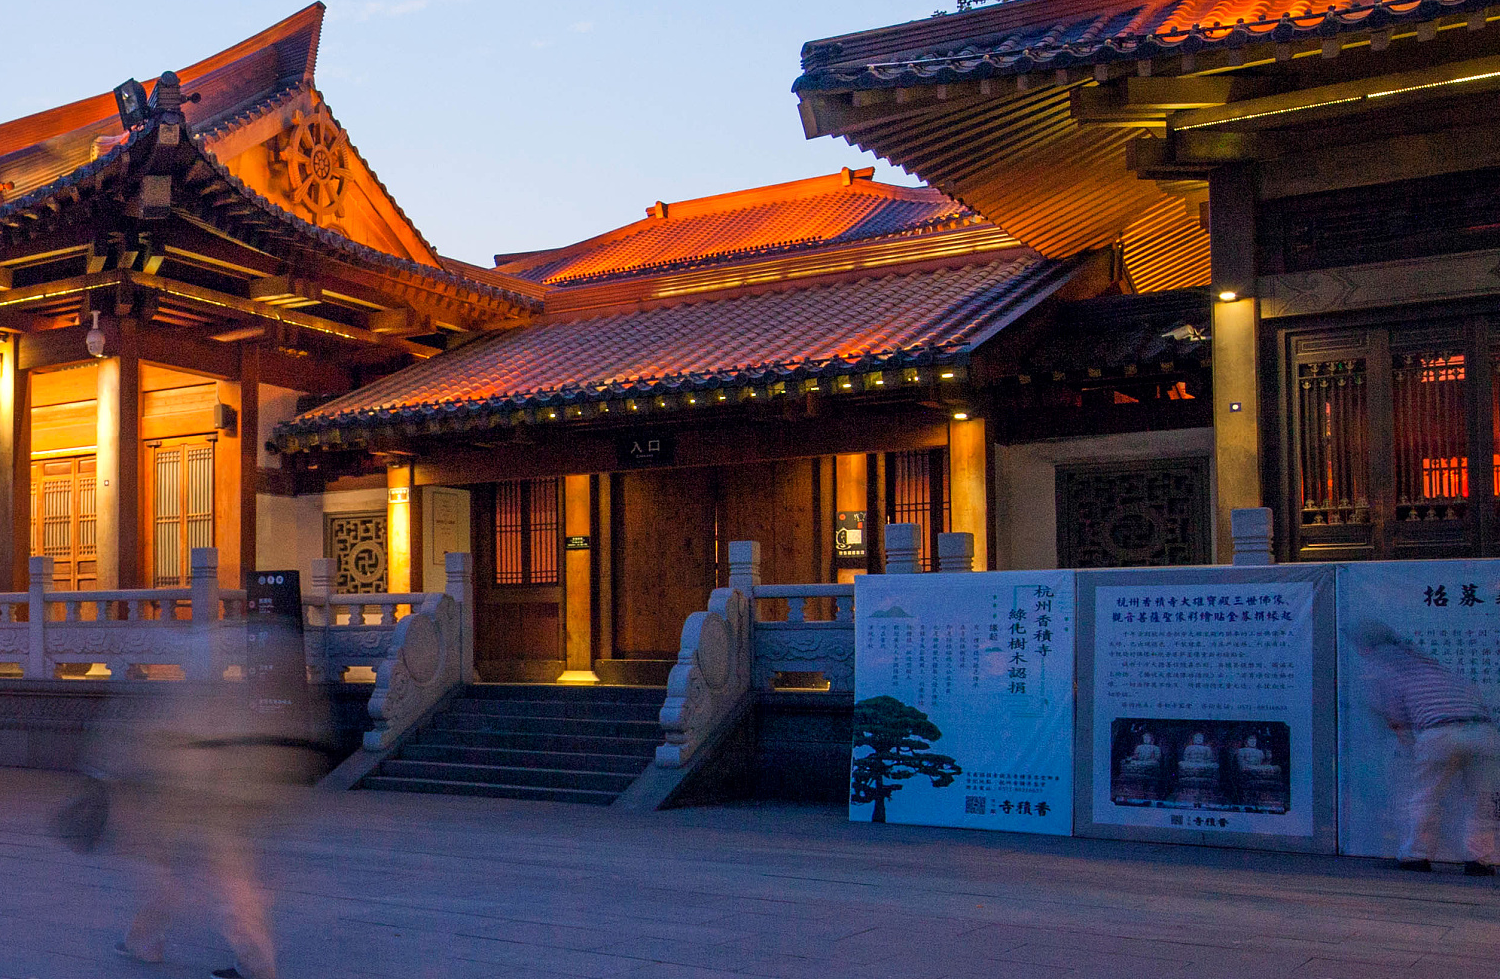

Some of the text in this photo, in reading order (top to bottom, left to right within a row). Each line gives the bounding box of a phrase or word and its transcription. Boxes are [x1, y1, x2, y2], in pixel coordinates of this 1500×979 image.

[630, 440, 660, 454] 入口
[1423, 583, 1500, 607] 招募
[1033, 585, 1054, 657] 杭州香積寺
[1008, 608, 1028, 694] 綠化樹木認捐
[999, 799, 1051, 817] 香積寺
